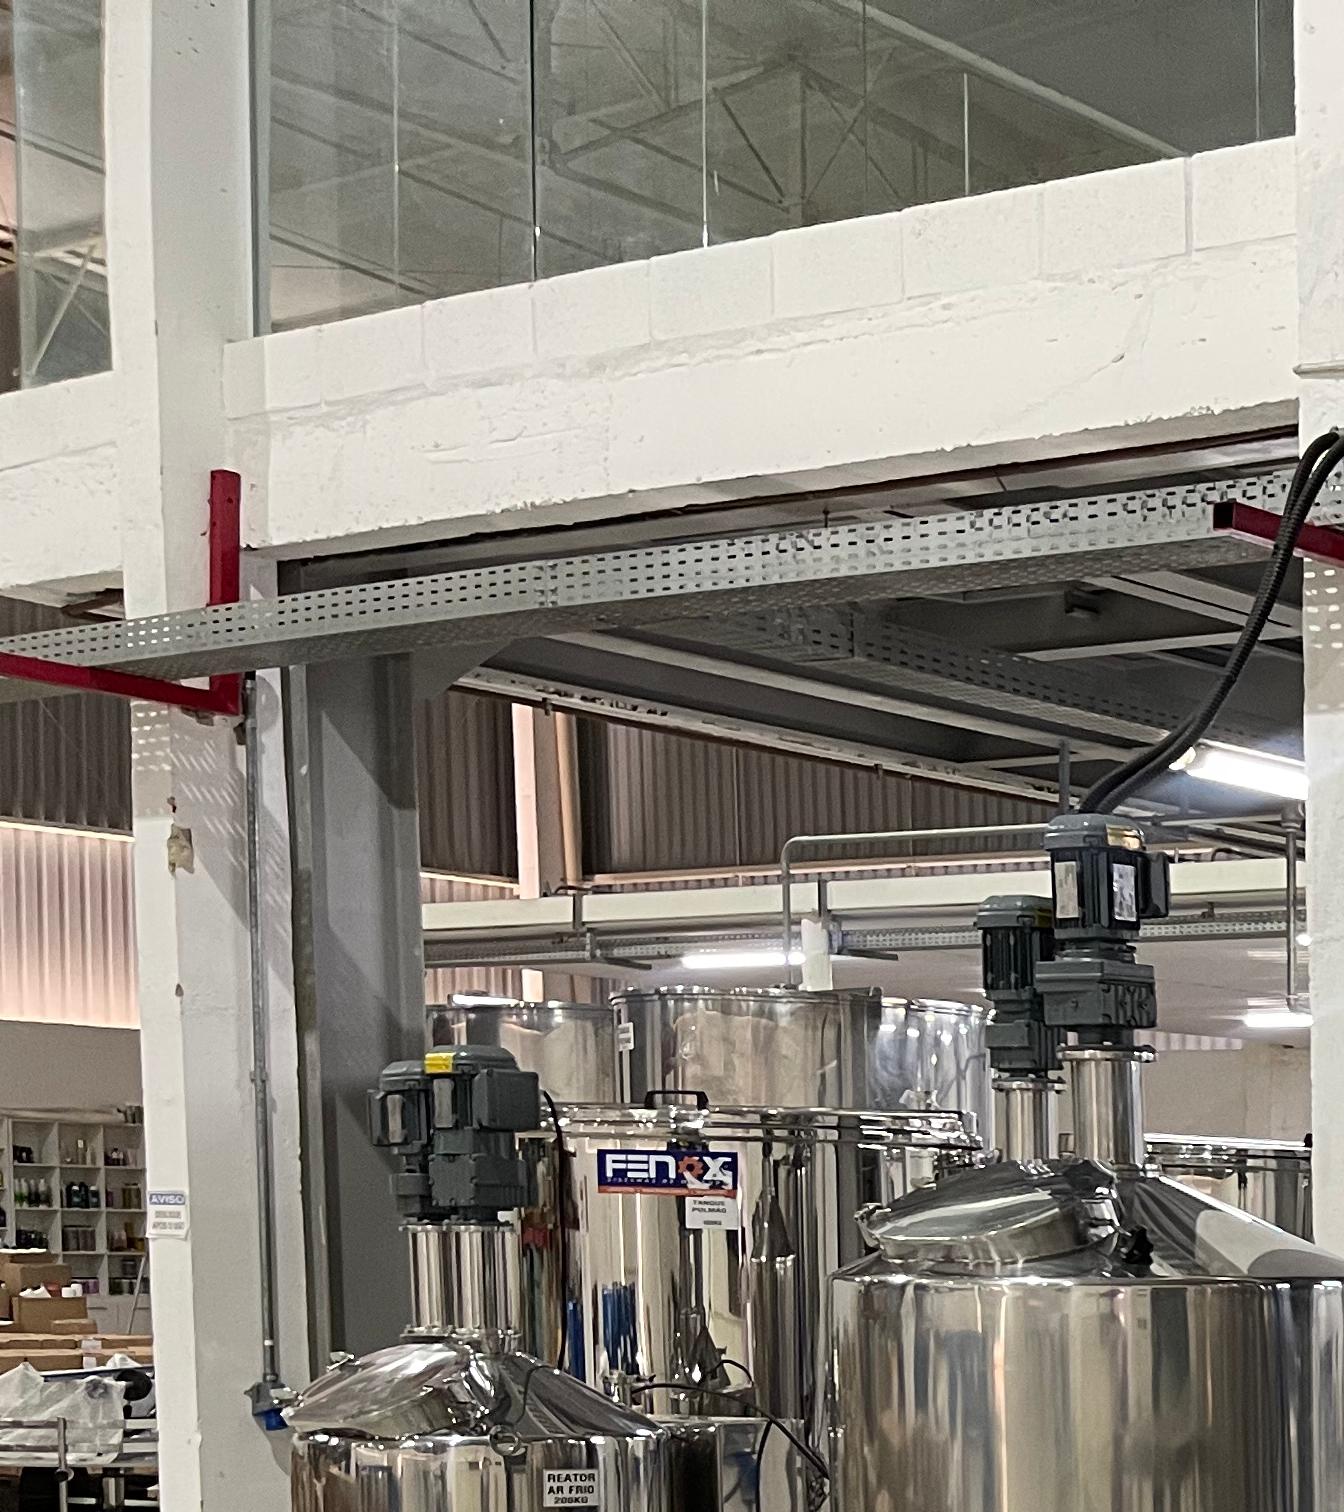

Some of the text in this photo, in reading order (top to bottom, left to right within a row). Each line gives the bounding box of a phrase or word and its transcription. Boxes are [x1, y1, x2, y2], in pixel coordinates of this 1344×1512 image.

[151, 1195, 185, 1204] AVISO
[547, 1473, 596, 1483] REATOR
[547, 1485, 595, 1495] AR FRIO
